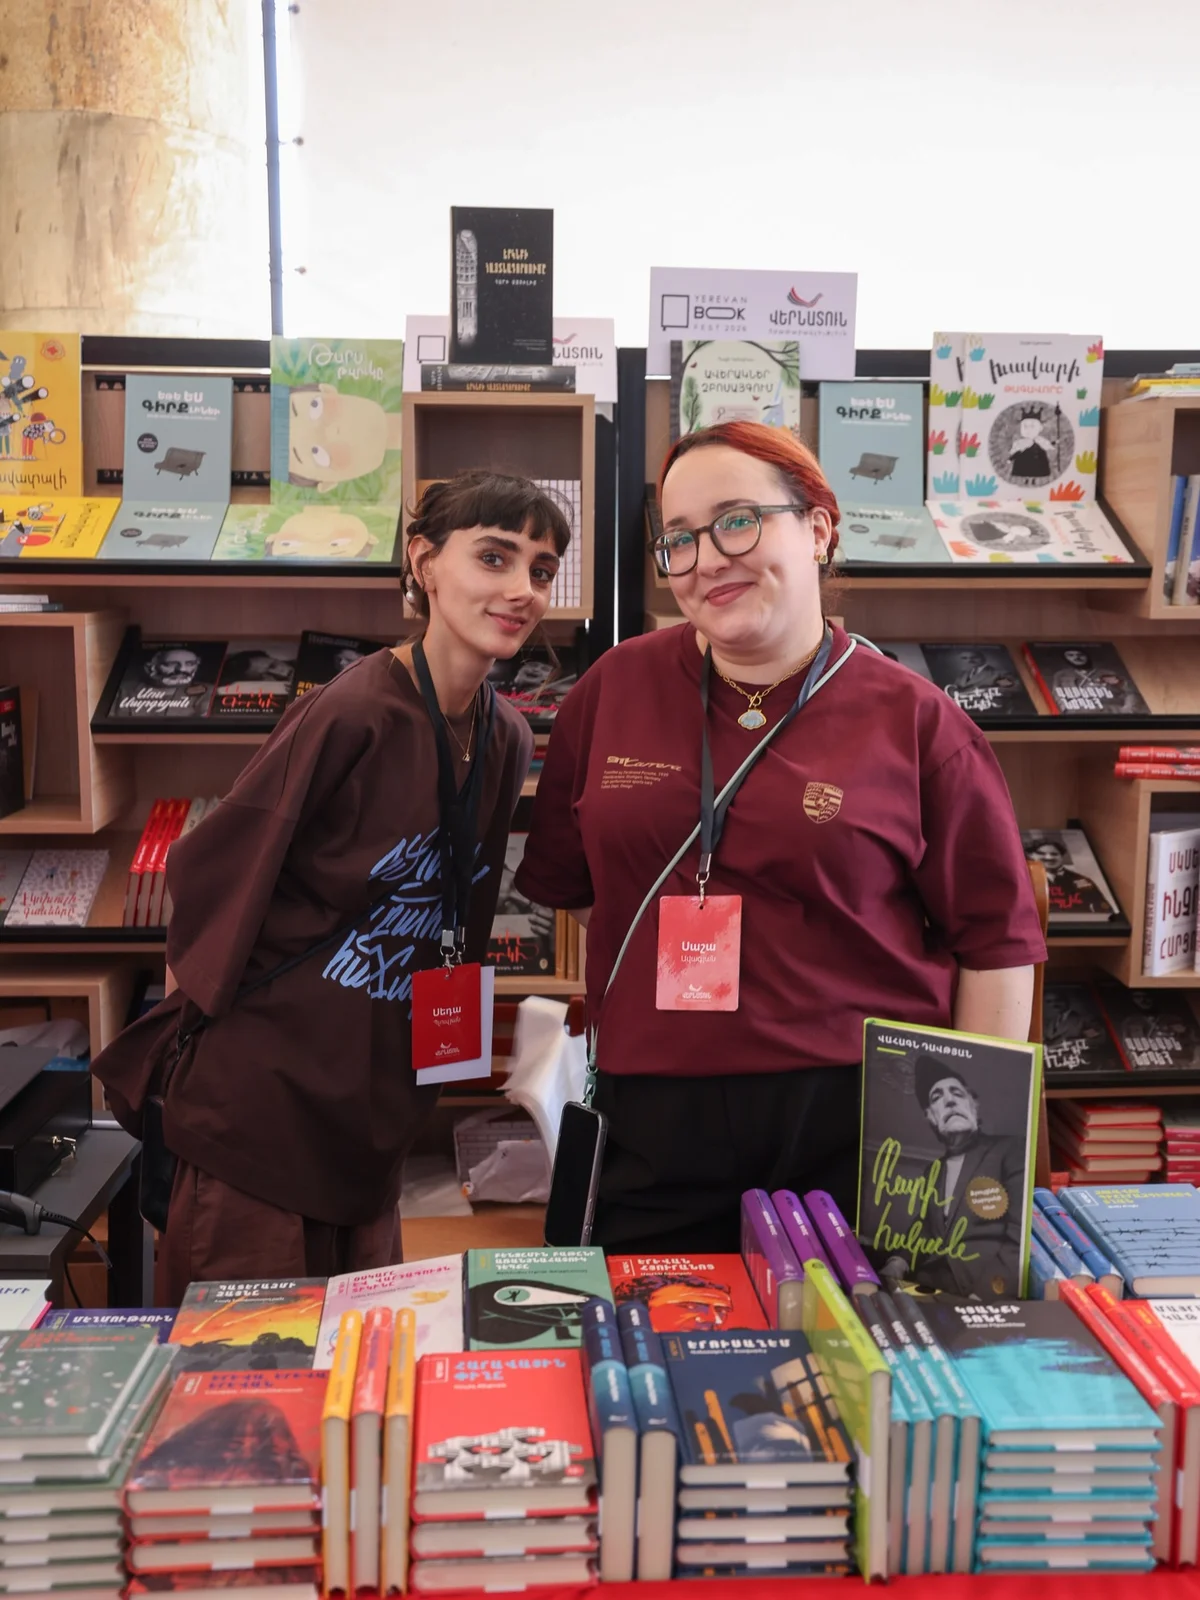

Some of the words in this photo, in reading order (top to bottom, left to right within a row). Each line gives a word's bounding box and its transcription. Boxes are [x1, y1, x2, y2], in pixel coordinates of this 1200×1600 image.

[694, 295, 748, 304] YEREVAN
[769, 309, 848, 327] ՎԵՐՆԱՏՈՒՆ
[694, 323, 719, 331] FEST
[704, 369, 771, 380] ԱՎԵՐԱԿՆԵՐ
[681, 941, 716, 954] Սաշա
[432, 1006, 462, 1017] Սեդա
[877, 1034, 920, 1050] ՎԱՀԱԳՆ
[921, 1042, 973, 1059] ԴԱՎԹՅԱՆ
[637, 1257, 690, 1265] ԵՐԵՎԱՆ
[640, 1263, 715, 1271] ՀՅՈՒՐԱՆՈՑ
[353, 1270, 397, 1282] ՕՍԿԱՐԸ
[72, 1315, 173, 1324] ՄԵՂՄՈՒԹՅՈՒՆ
[687, 1338, 791, 1350] ԵՐՈՒՍԱՂԵՄ
[455, 1357, 567, 1371] ՀԱՐԱՎԱՅԻՆ
